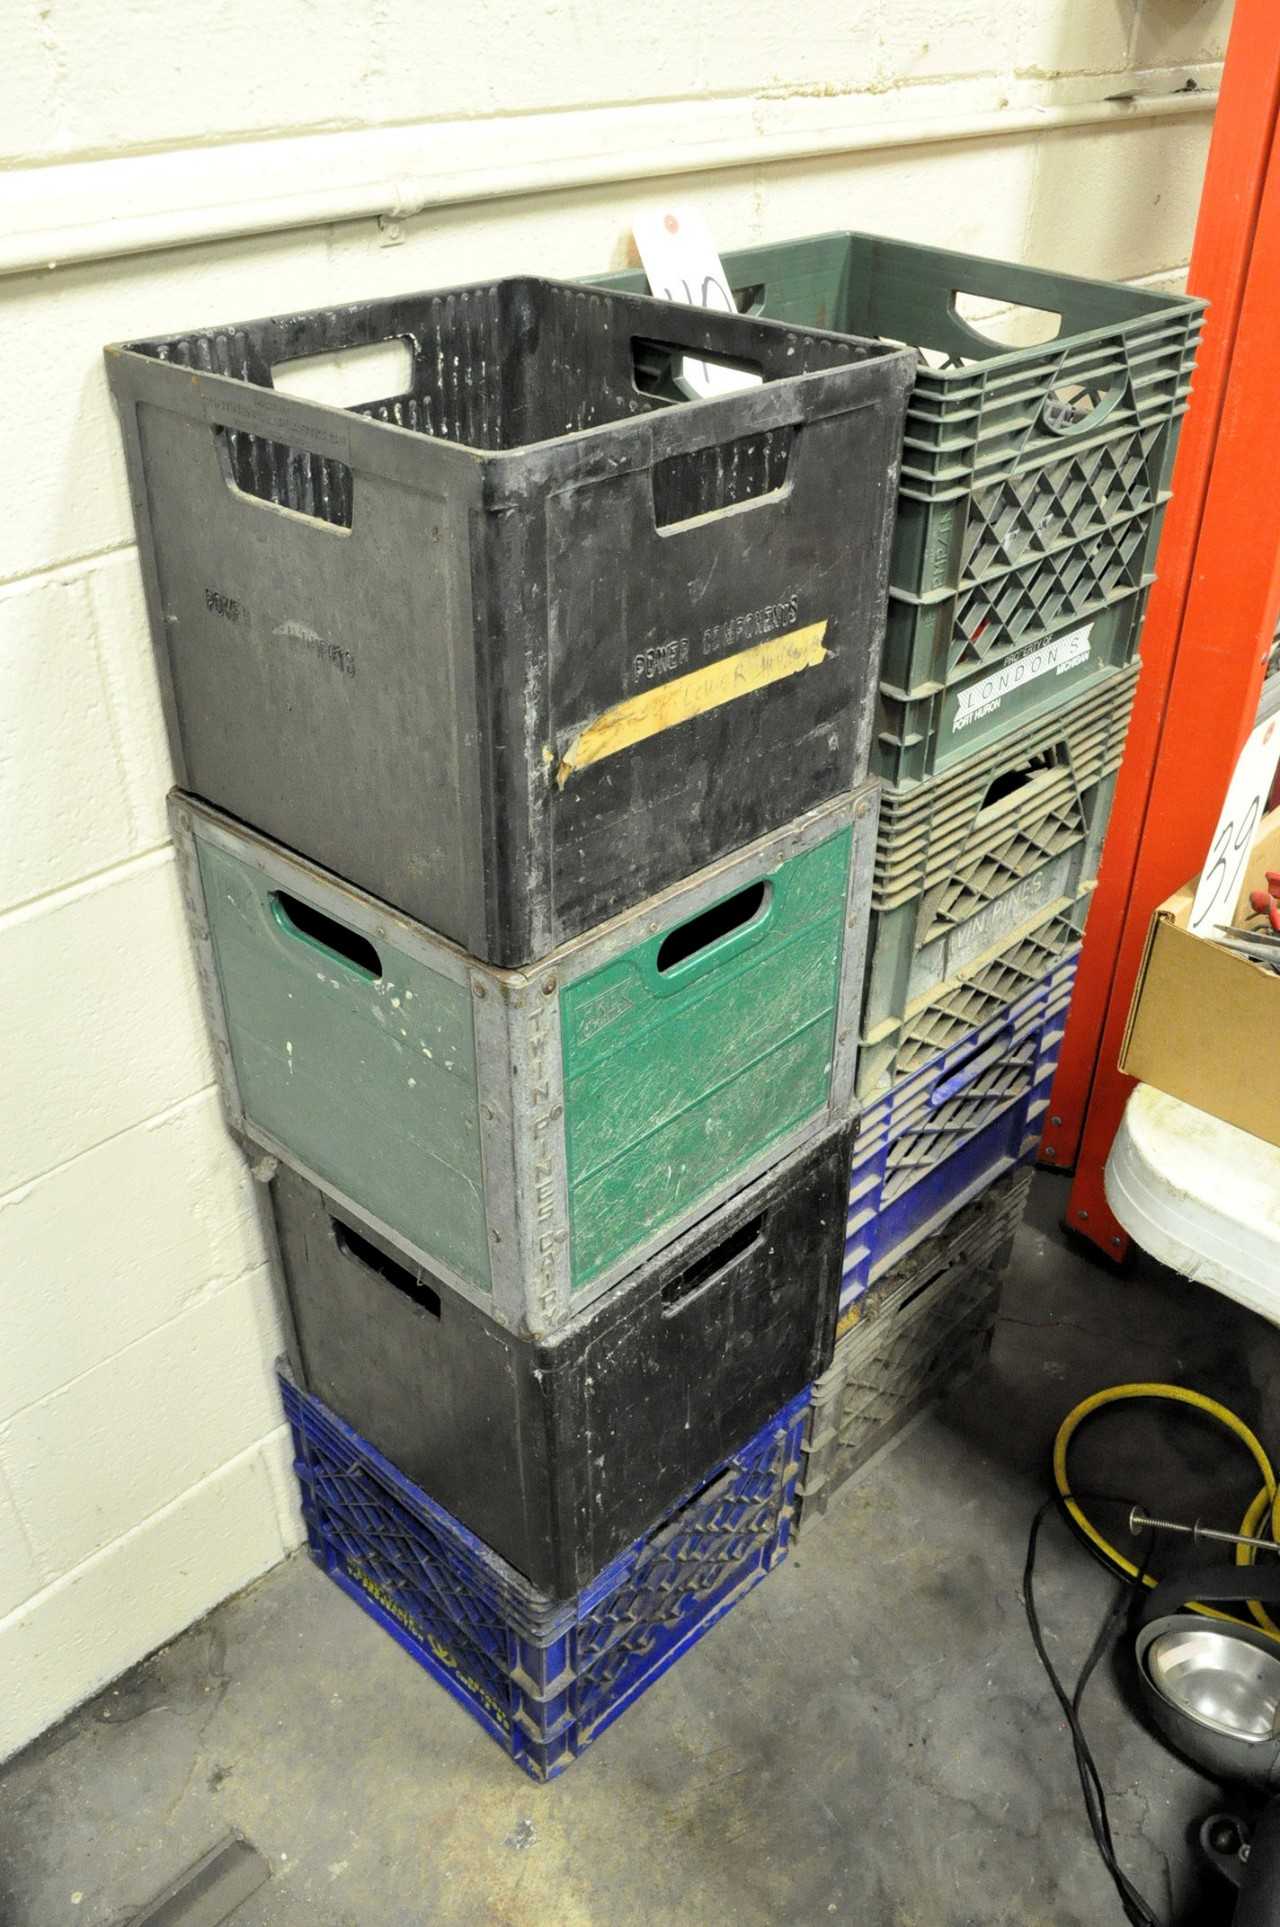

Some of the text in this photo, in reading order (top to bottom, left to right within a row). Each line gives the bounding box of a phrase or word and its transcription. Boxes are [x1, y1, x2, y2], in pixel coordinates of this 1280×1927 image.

[632, 637, 689, 684] POWER
[967, 636, 1080, 709] LONDONS
[1192, 794, 1260, 929] 39
